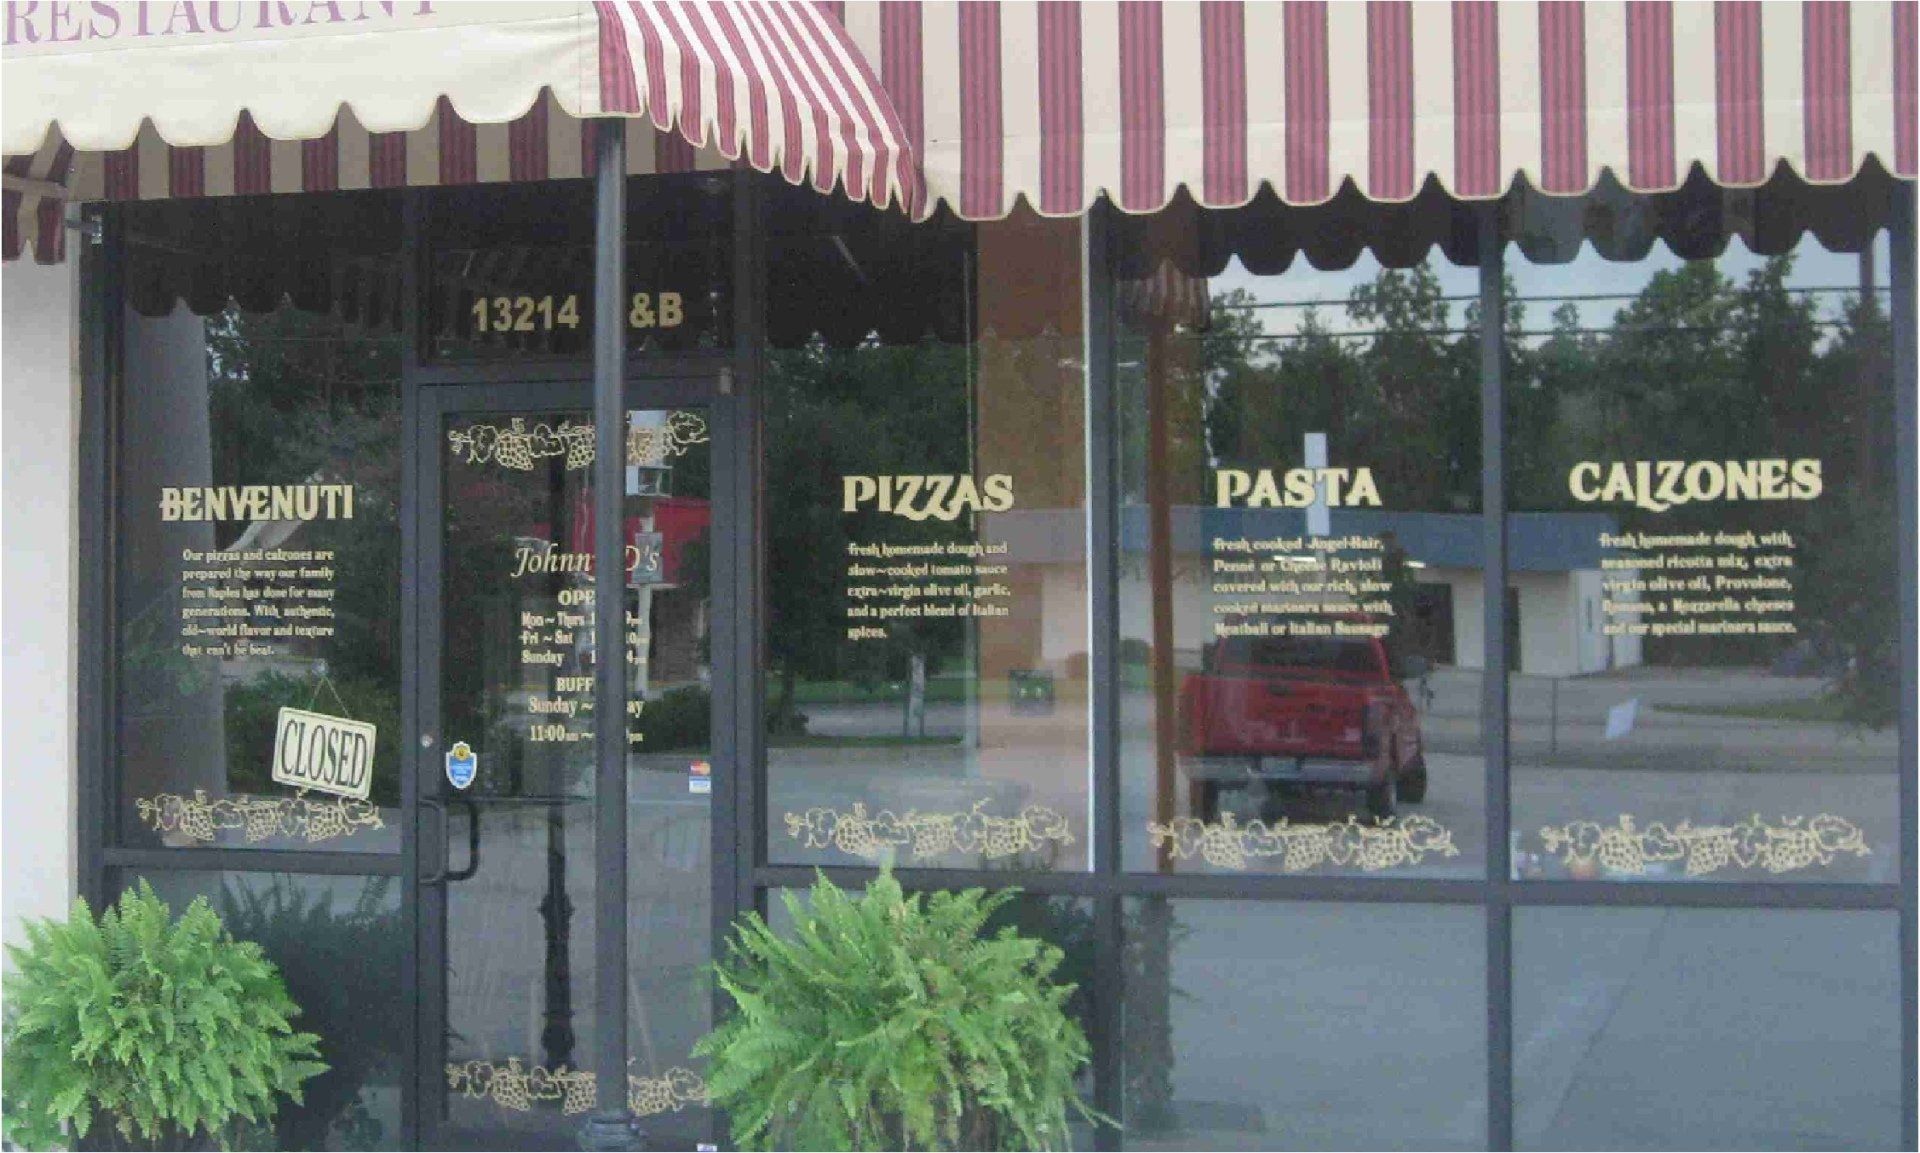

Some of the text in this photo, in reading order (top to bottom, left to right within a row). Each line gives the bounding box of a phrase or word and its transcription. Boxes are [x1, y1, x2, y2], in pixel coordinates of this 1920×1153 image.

[1, 2, 437, 45] RESTAUR
[471, 294, 580, 332] 13214
[1217, 467, 1382, 508] PASTA
[1569, 459, 1822, 512] CALZONES
[159, 485, 353, 521] BENVENUTI
[842, 474, 1014, 521] PIZZAS
[1254, 537, 1302, 552] cooked
[1639, 532, 1711, 548] homemade
[1715, 531, 1757, 548] dough
[1760, 530, 1796, 549] with
[183, 549, 334, 563] Our pizzas and calzones are
[883, 543, 944, 557] homemade
[947, 542, 984, 557] dough
[987, 542, 1007, 553] and
[510, 536, 595, 581] Johnn
[1261, 562, 1274, 571] or
[1331, 557, 1382, 573] Ravioli
[1602, 554, 1663, 568] seasoned
[1667, 555, 1713, 568] ricotta
[1754, 555, 1792, 569] extra
[183, 567, 334, 583] prepared the way our family
[931, 565, 971, 575] tomato
[976, 566, 1007, 575] sauce
[924, 584, 952, 596] olive
[954, 584, 972, 596] oil,
[1213, 581, 1265, 592] covered
[1270, 580, 1299, 595] with
[1302, 583, 1323, 592] our
[1360, 578, 1392, 592] slow
[1603, 575, 1792, 593] virgin olive oil, Provolone,
[183, 587, 335, 601] from Naples has done for many
[558, 589, 595, 605] OPE
[183, 607, 250, 619] generations.
[254, 605, 281, 619] With
[848, 606, 868, 616] and
[879, 605, 920, 618] perfect
[924, 605, 954, 616] blend
[958, 604, 968, 616] of
[973, 604, 1008, 616] Italian
[1362, 601, 1396, 615] with
[521, 611, 544, 628] Mon
[240, 624, 271, 636] flavor
[274, 625, 292, 636] and
[296, 626, 334, 638] texture
[1271, 625, 1286, 635] or
[1290, 622, 1331, 635] Italian
[1652, 620, 1695, 636] special
[519, 630, 538, 645] Fri
[555, 629, 573, 644] Sat
[183, 644, 201, 657] that
[207, 644, 231, 655] can't
[234, 644, 247, 655] be
[521, 650, 564, 666] Sunday
[557, 677, 593, 692] BUFF
[529, 696, 578, 718] Sunday
[281, 718, 367, 788] CLOSED
